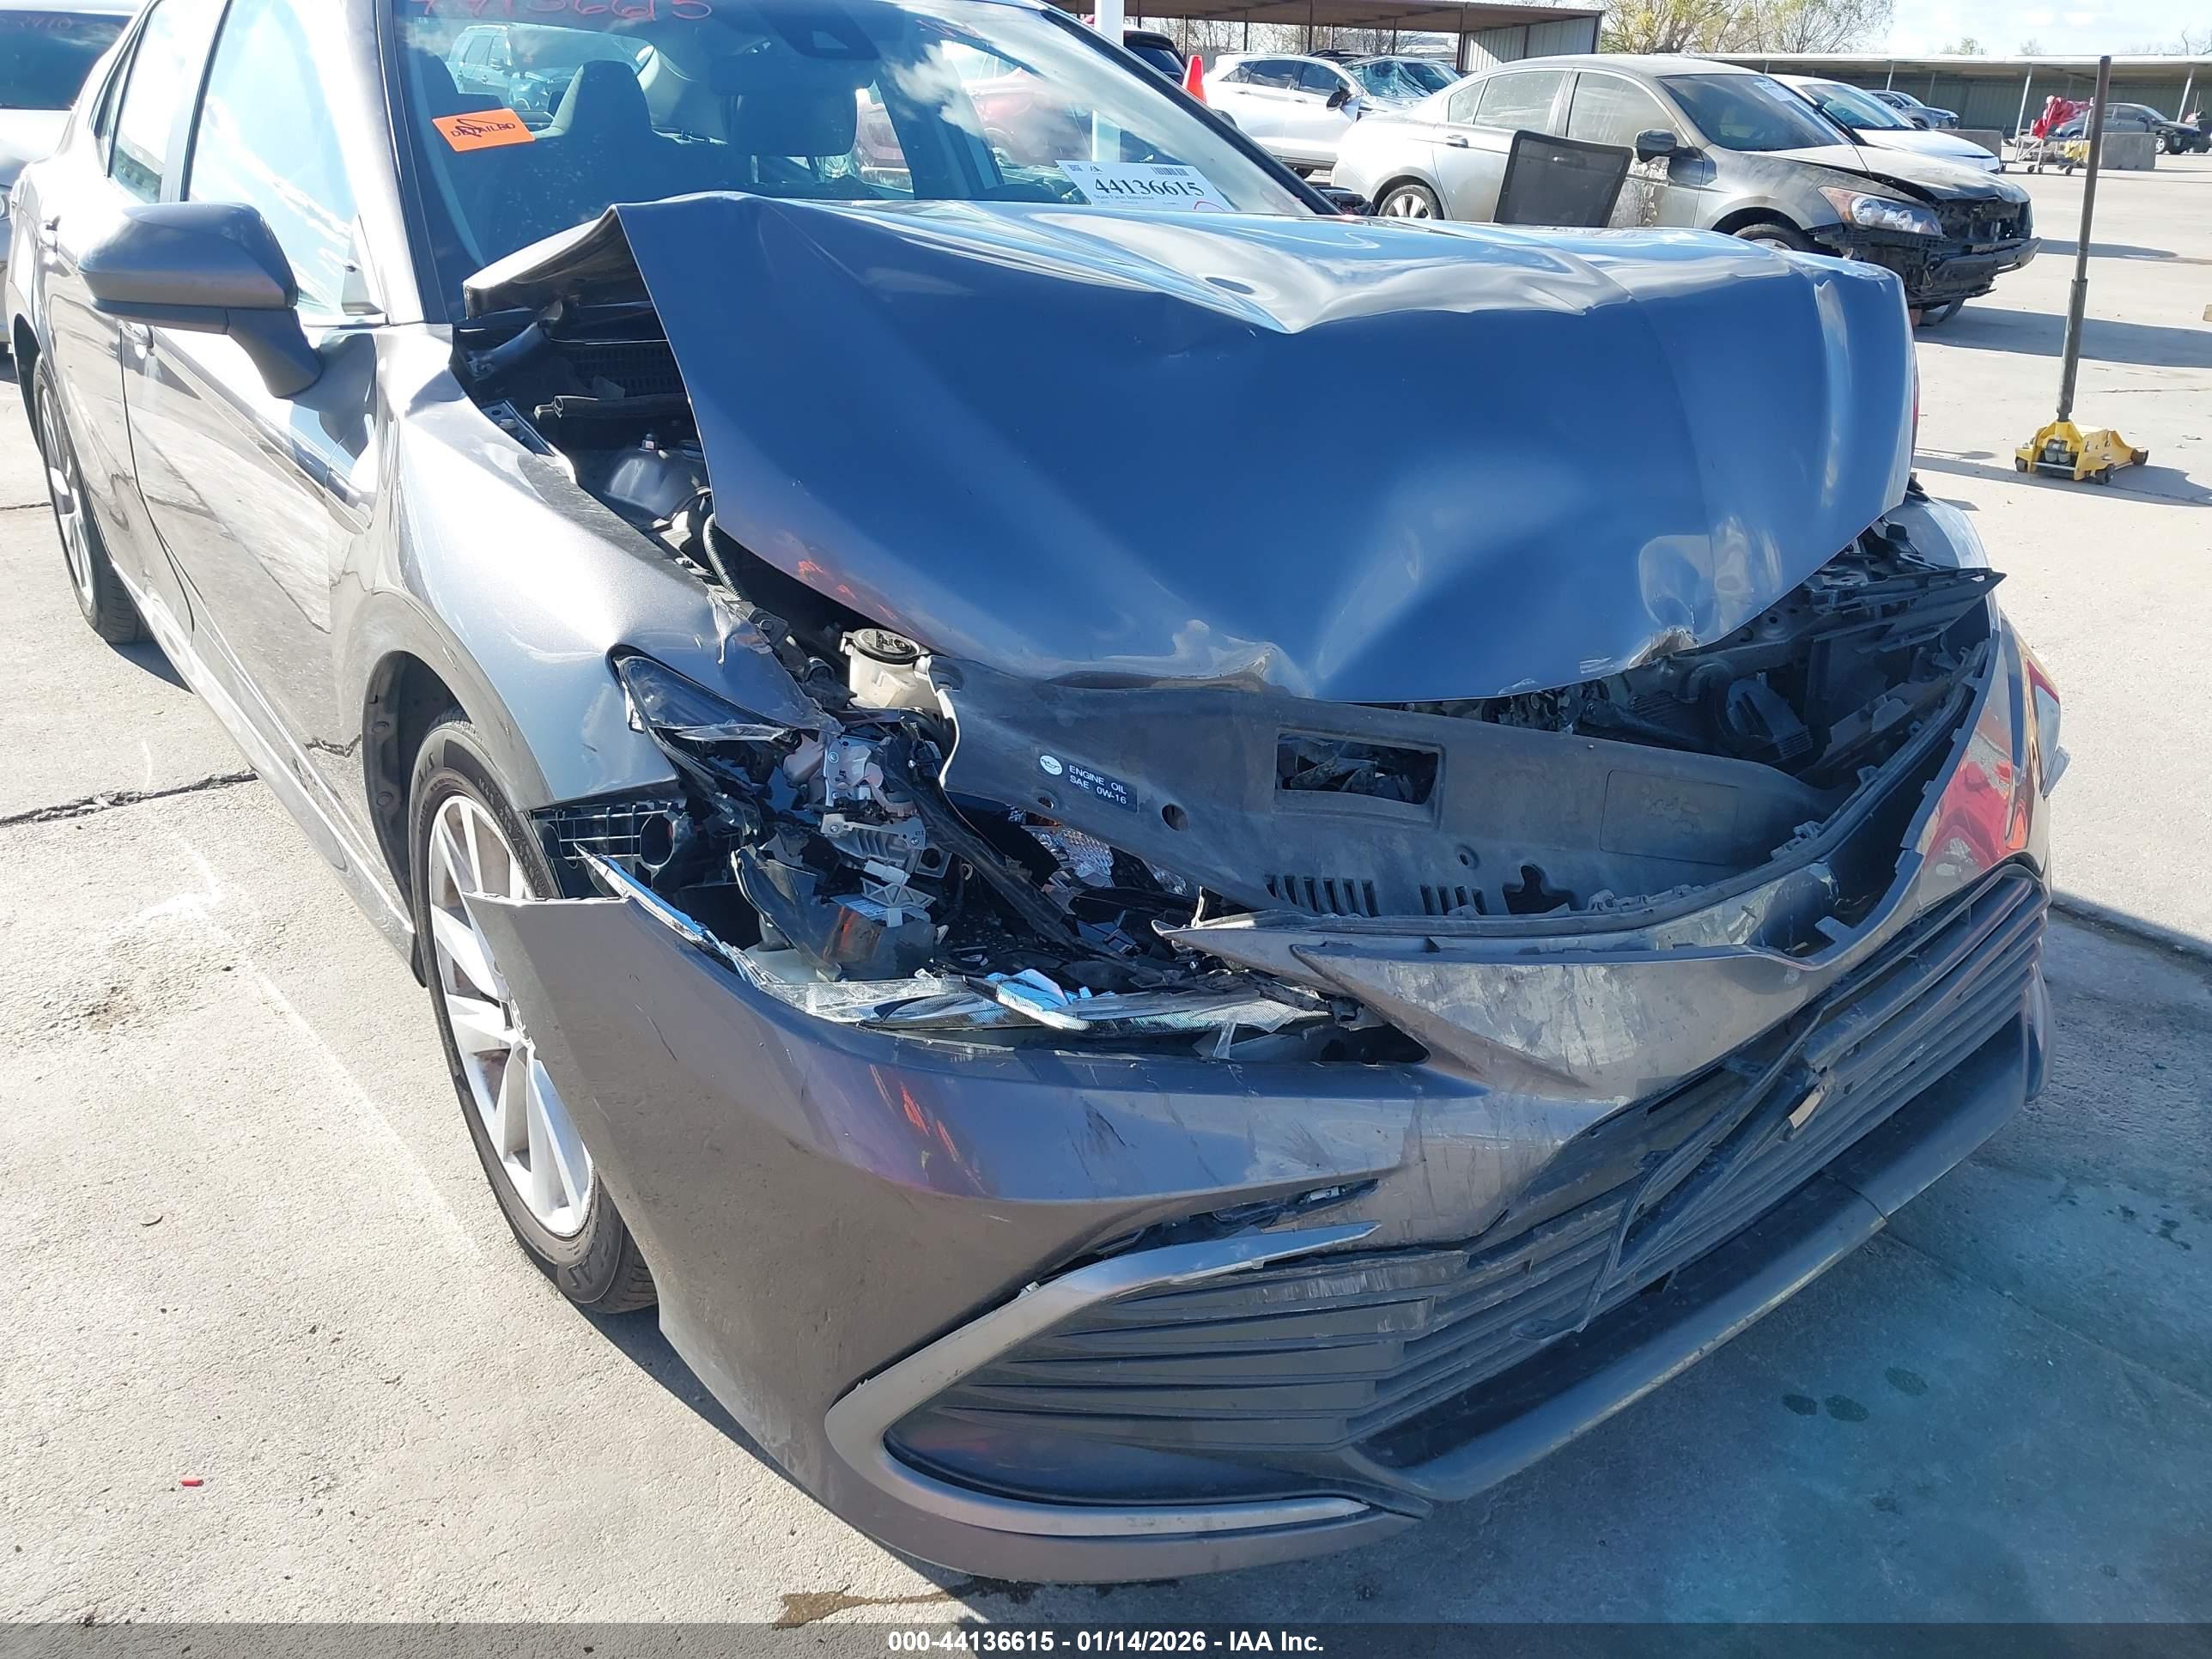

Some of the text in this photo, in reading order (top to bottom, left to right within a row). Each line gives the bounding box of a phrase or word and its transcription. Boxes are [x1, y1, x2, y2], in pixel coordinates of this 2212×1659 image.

[1094, 178, 1205, 197] 44136615
[1068, 763, 1127, 795] ENGINE OIL
[1069, 775, 1127, 805] SAE 0W-16
